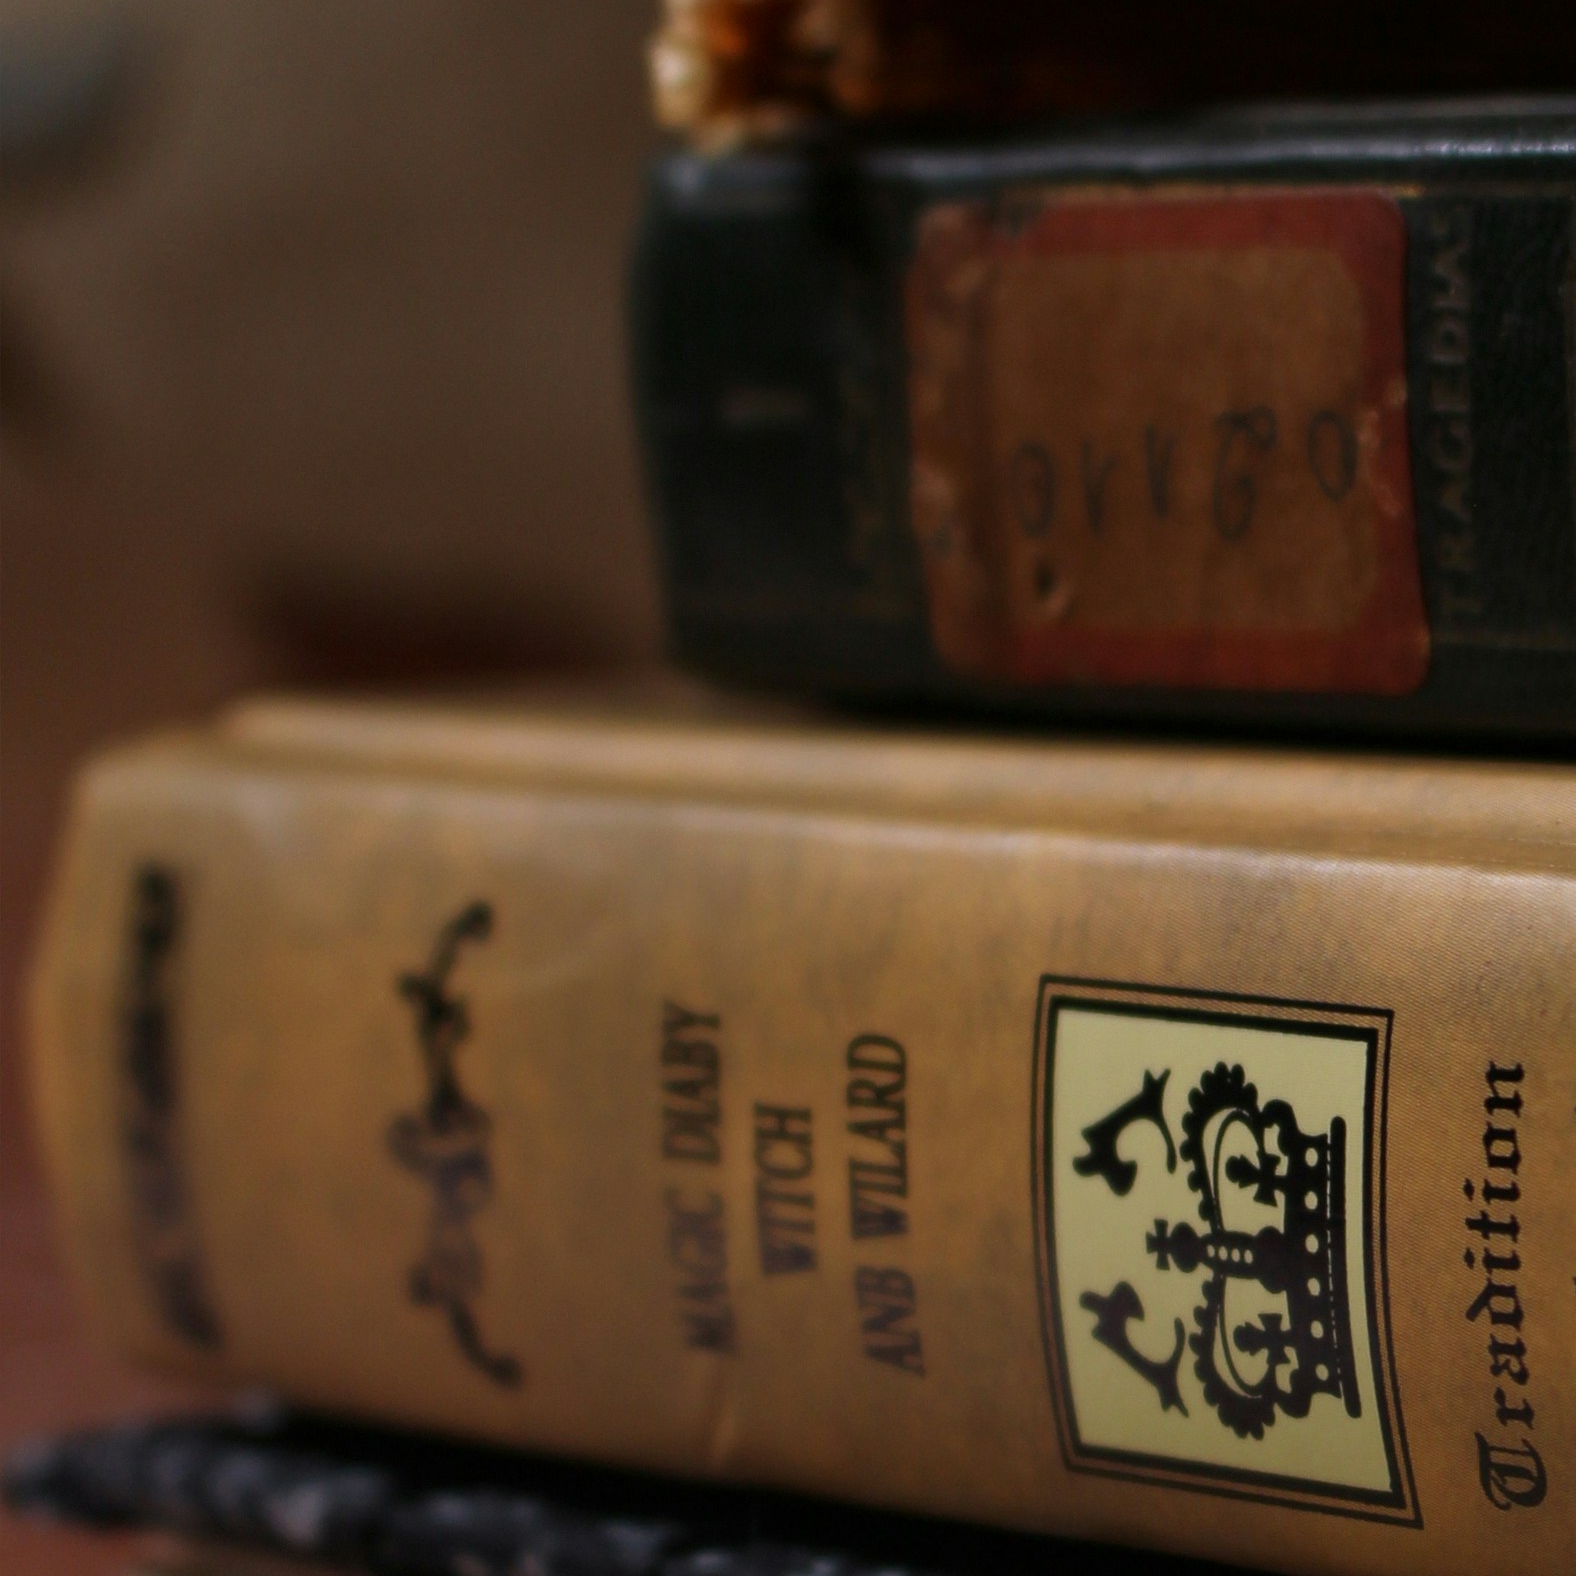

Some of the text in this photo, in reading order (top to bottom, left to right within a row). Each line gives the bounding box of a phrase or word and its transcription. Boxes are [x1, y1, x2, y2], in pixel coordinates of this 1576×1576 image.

[1426, 204, 1484, 617] TRAGEDIAS
[663, 1190, 735, 1354] MAGIC
[753, 1102, 816, 1275] WITCH
[1464, 1061, 1548, 1509] Tradition
